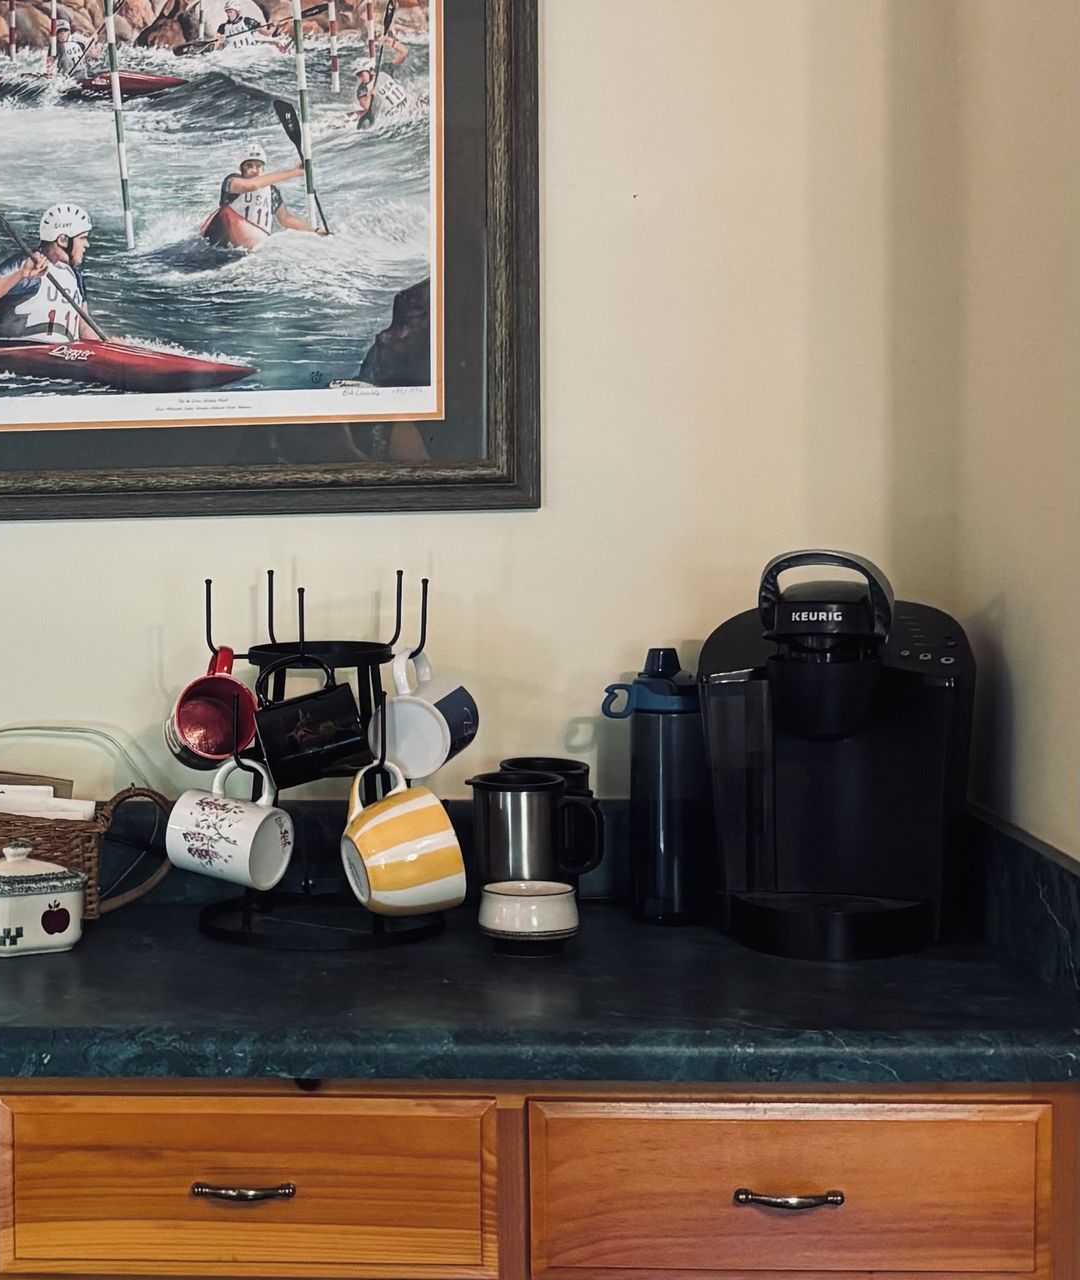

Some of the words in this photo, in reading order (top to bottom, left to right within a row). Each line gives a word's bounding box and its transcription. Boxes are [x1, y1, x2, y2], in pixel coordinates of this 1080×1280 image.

[378, 81, 394, 96] USA
[385, 87, 404, 106] 111
[244, 192, 269, 208] USA
[244, 205, 269, 227] 111
[47, 286, 80, 305] USA
[791, 611, 843, 621] KEURIG
